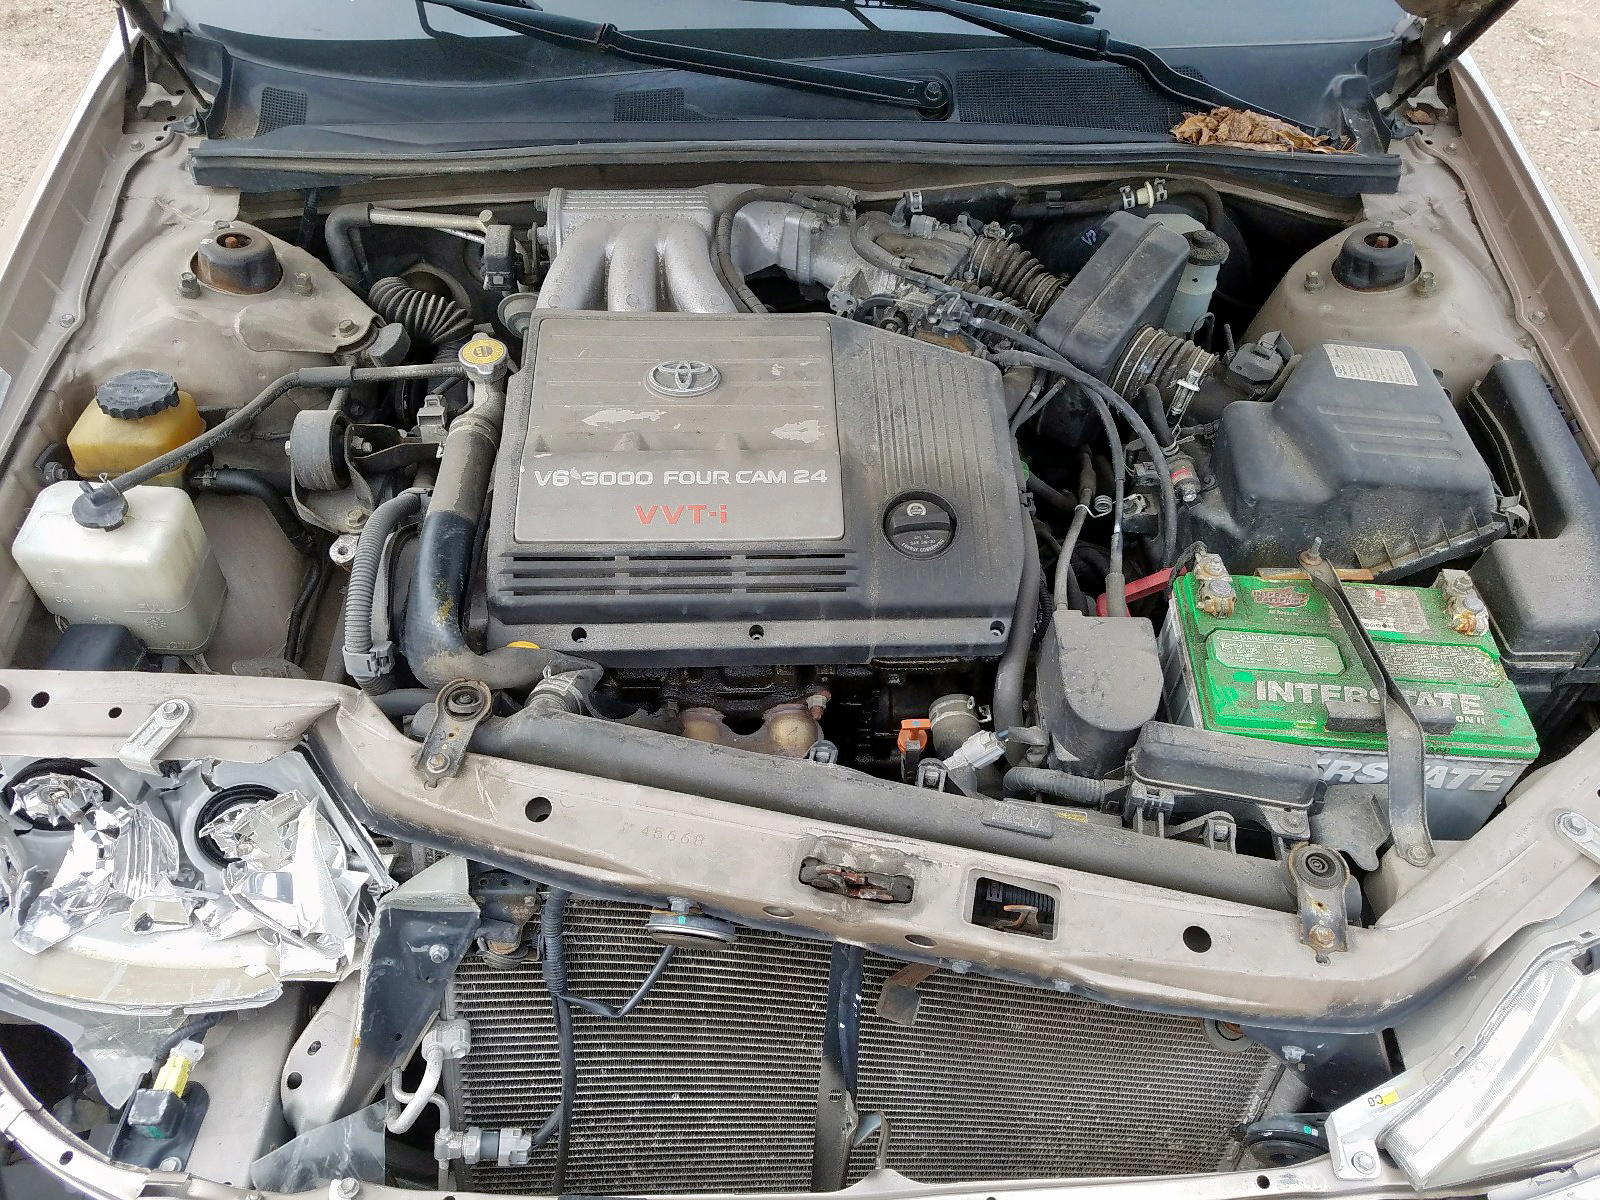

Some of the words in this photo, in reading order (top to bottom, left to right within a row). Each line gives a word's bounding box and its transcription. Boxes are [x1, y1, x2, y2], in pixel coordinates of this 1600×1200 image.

[534, 470, 569, 487] V6
[580, 470, 654, 486] 3000
[663, 470, 731, 485] FOUR
[735, 469, 787, 485] CAM
[793, 469, 828, 484] 24
[634, 503, 728, 525] VVT-i
